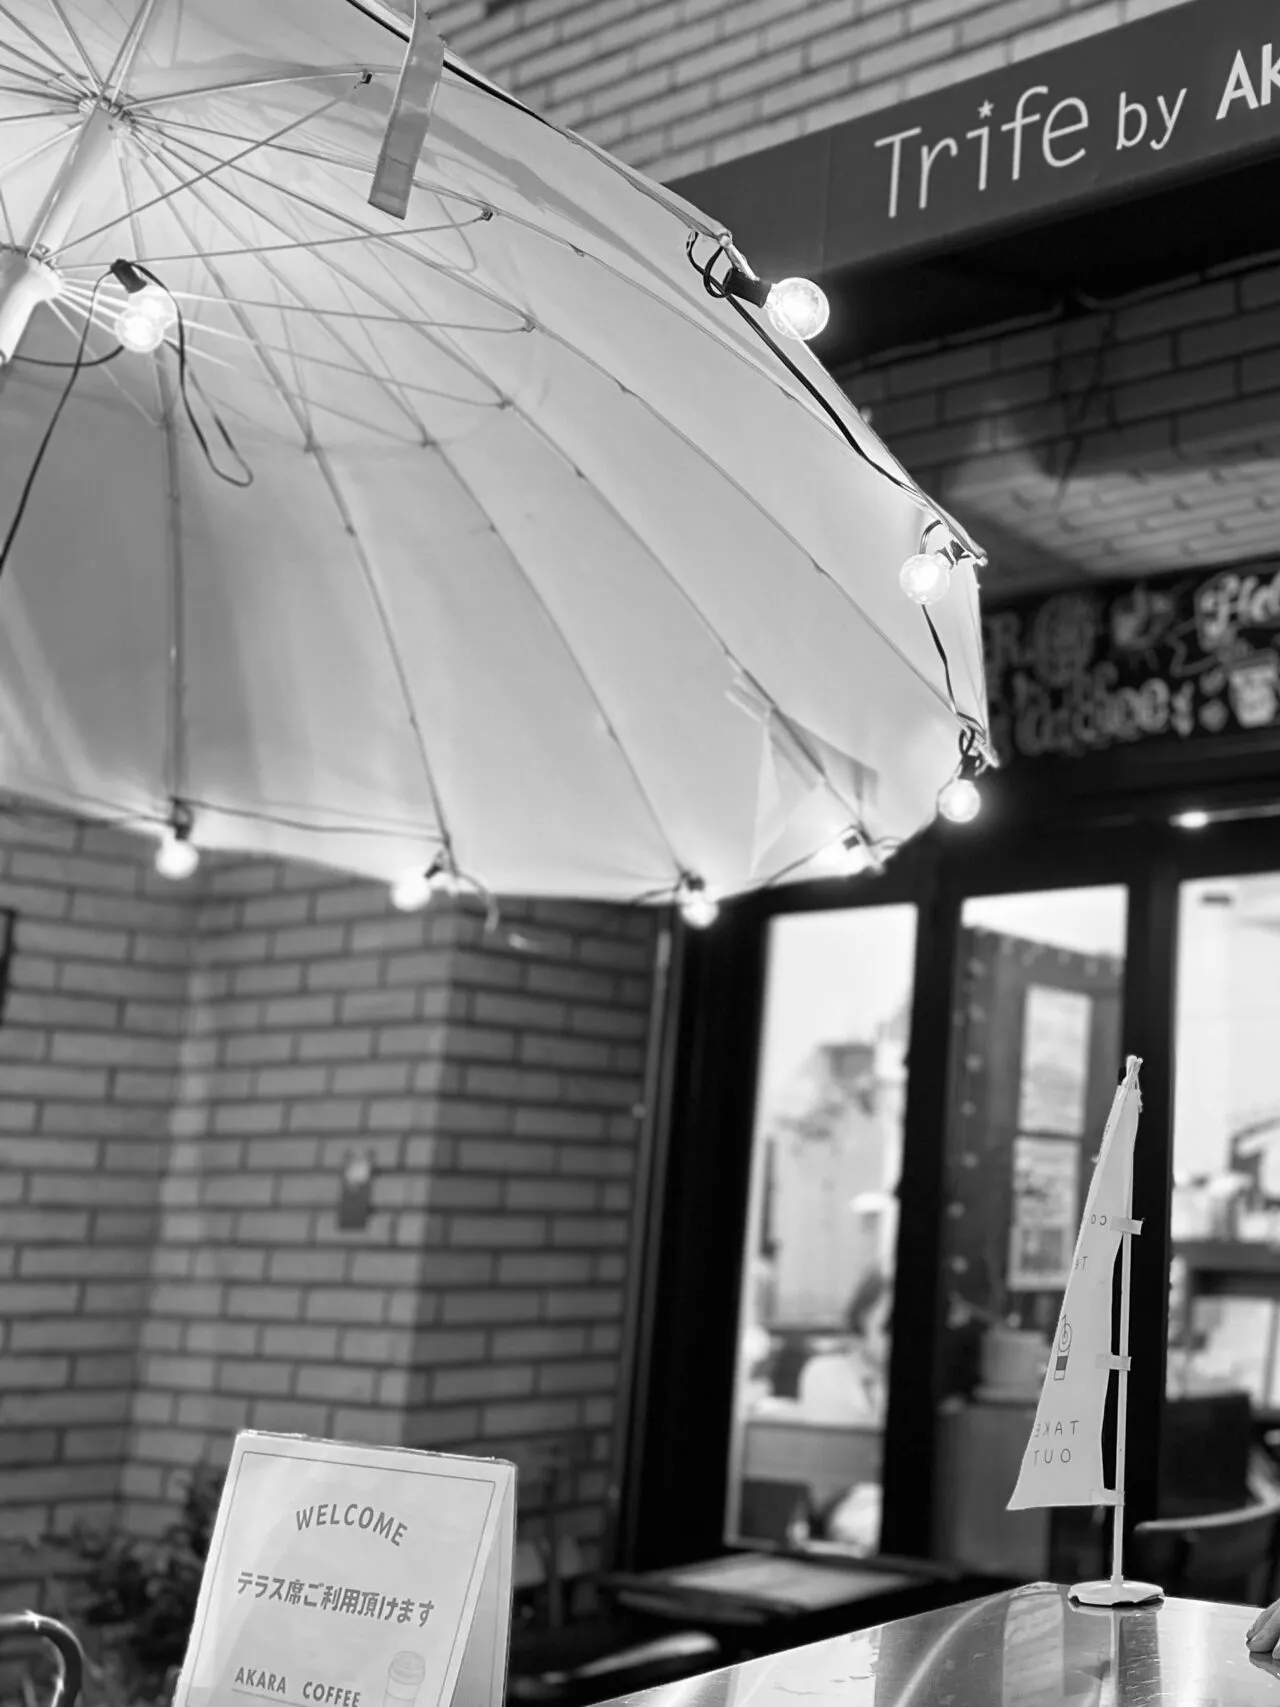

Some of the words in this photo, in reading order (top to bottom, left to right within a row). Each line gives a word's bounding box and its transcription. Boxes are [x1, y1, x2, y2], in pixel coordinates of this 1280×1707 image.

[873, 85, 1090, 219] Trife
[1116, 87, 1188, 150] by
[295, 1503, 409, 1547] WELCOME
[237, 1570, 435, 1629] テラス席ご利用頂けます
[234, 1666, 287, 1695] AKARA
[301, 1680, 362, 1707] COFFEE
